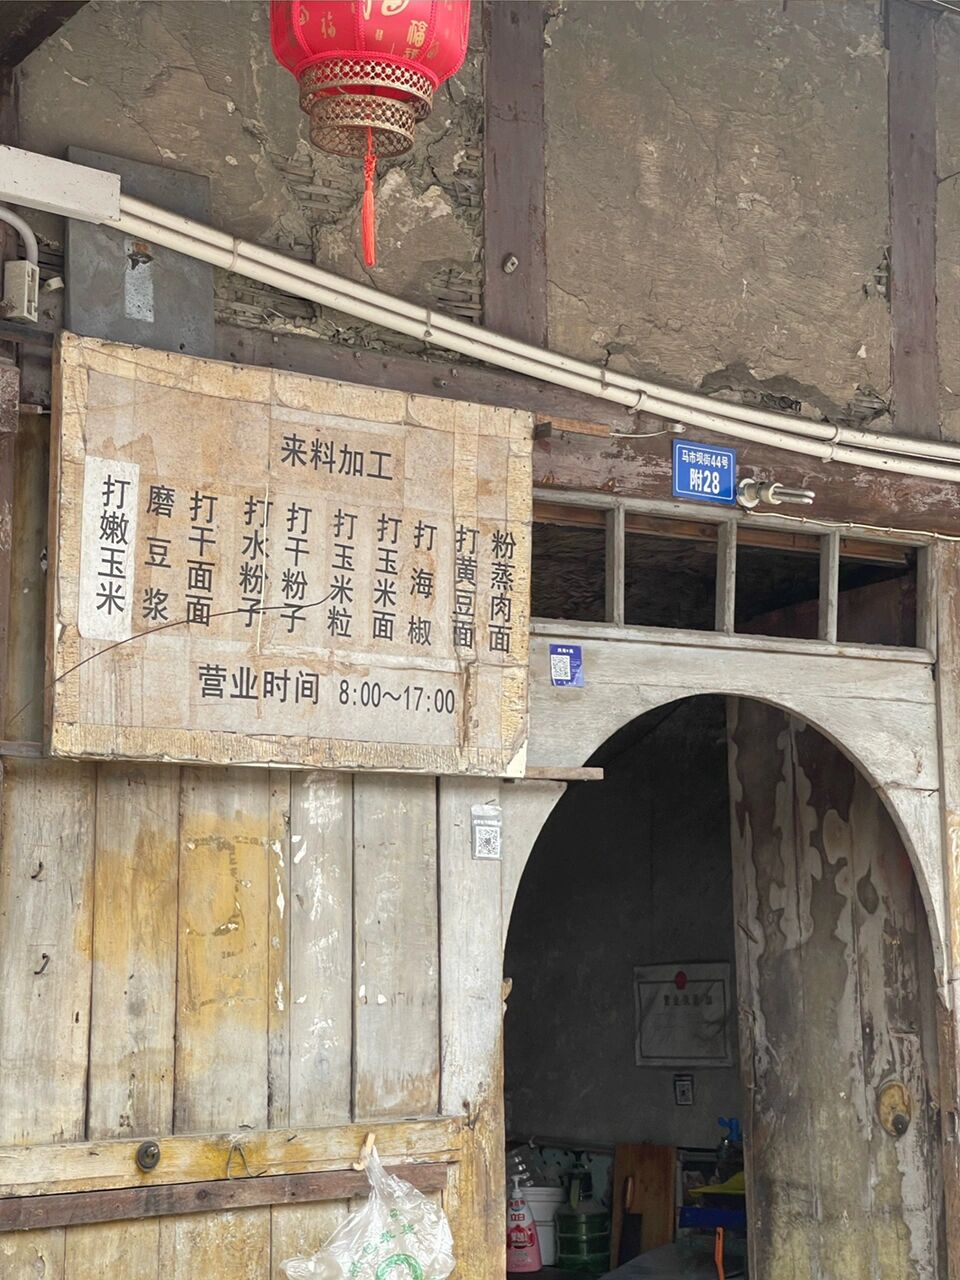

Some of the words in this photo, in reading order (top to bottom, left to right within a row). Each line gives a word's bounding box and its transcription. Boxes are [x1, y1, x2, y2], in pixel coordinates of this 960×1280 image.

[281, 432, 393, 481] 来料加工
[681, 449, 729, 469] 马市坝街44号
[689, 467, 720, 495] 附28
[96, 474, 131, 616] 打嫩玉米
[142, 485, 175, 621] 磨豆浆
[185, 491, 218, 627] 打干面面
[238, 495, 273, 628] 打水粉子
[280, 502, 312, 634] 打干粉子
[327, 508, 358, 638] 打玉米粒
[372, 513, 402, 641] 打玉米面
[408, 520, 438, 646] 打海椒
[452, 524, 480, 649] 打黄豆面
[488, 529, 516, 654] 粉蒸肉面
[198, 663, 320, 705] 营业时间
